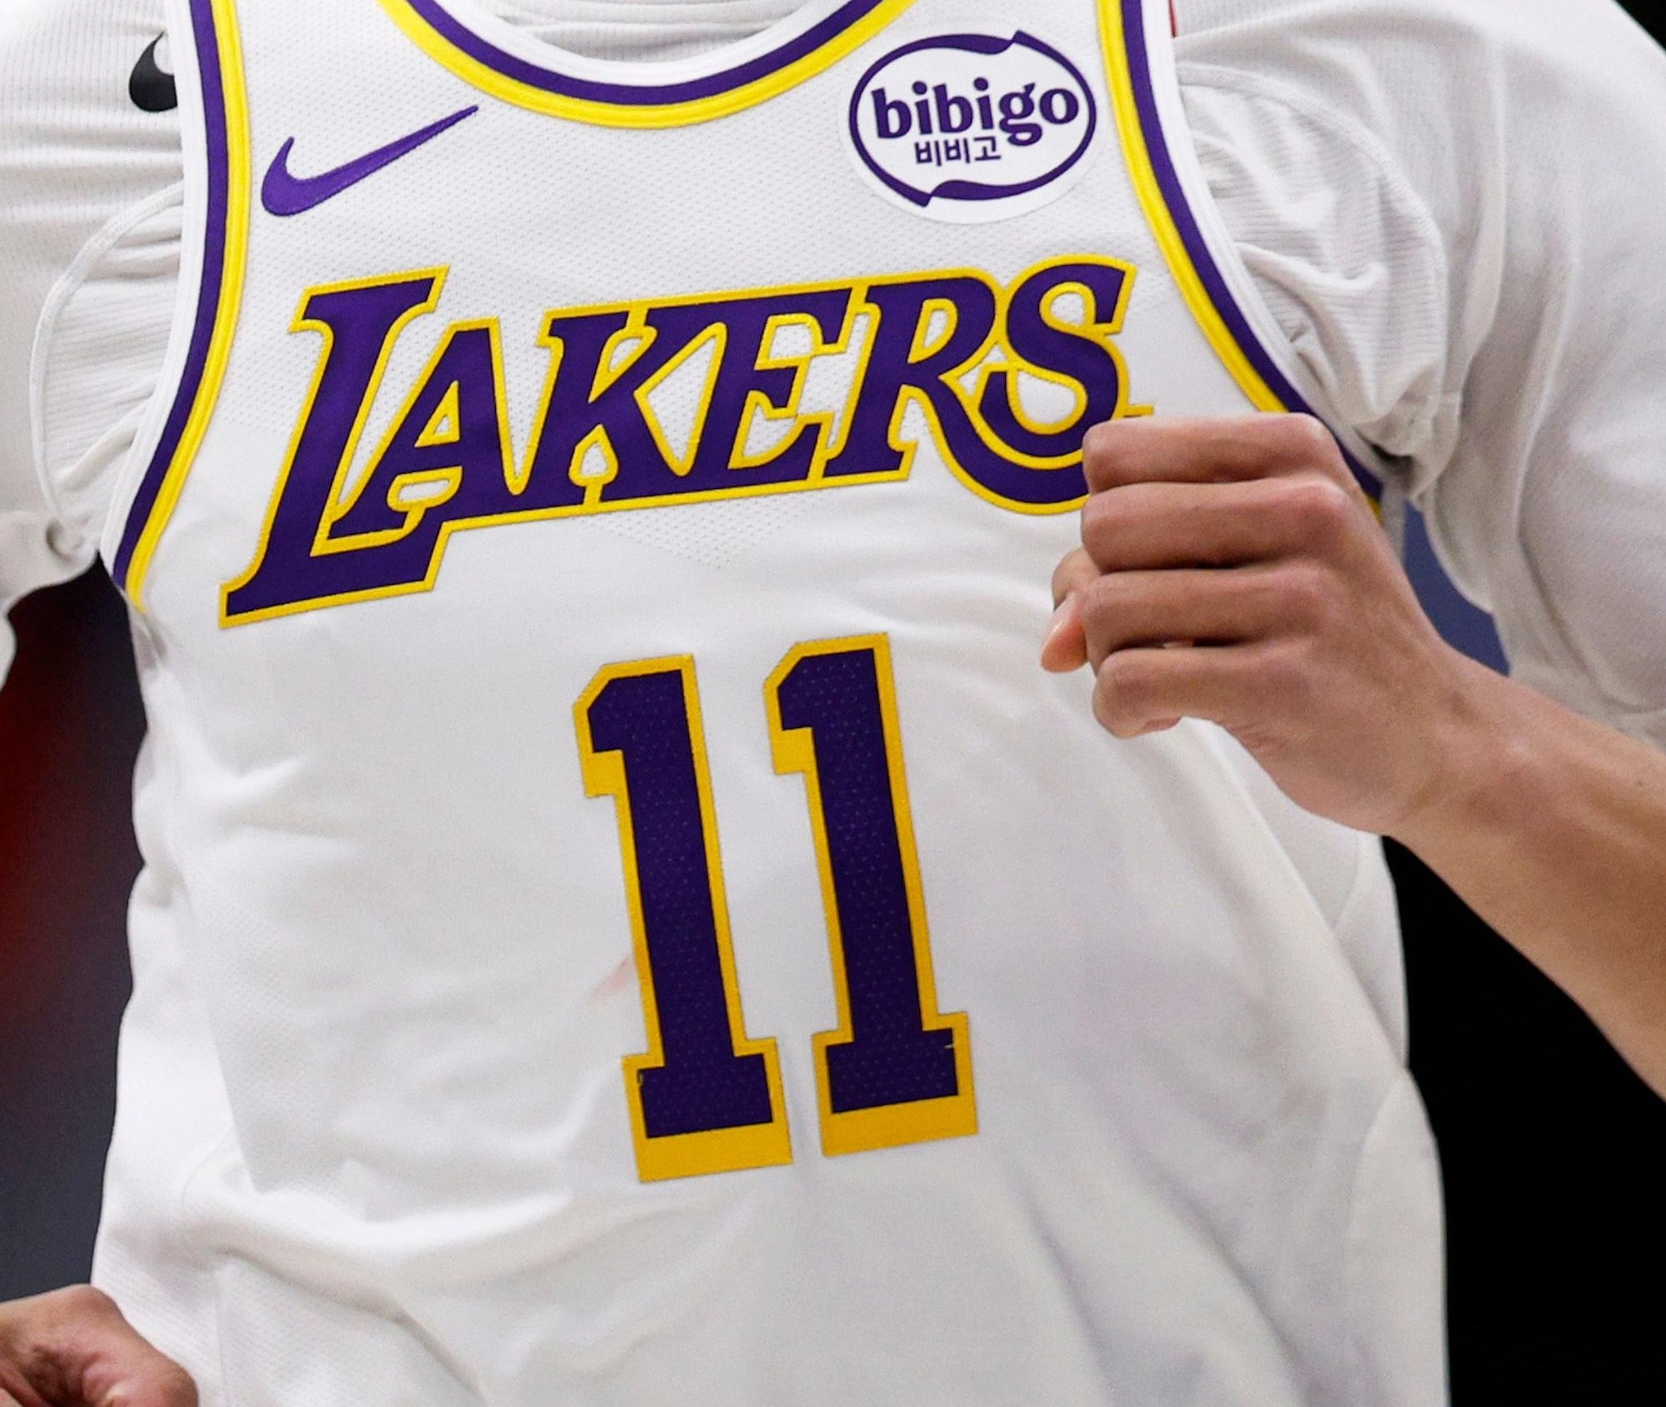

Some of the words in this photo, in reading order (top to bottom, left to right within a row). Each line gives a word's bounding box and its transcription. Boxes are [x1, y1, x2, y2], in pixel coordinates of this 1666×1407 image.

[871, 77, 1079, 146] bibigo
[914, 136, 1001, 166] 비비고
[219, 253, 1155, 628] LAKERS
[572, 632, 980, 1183] 11
